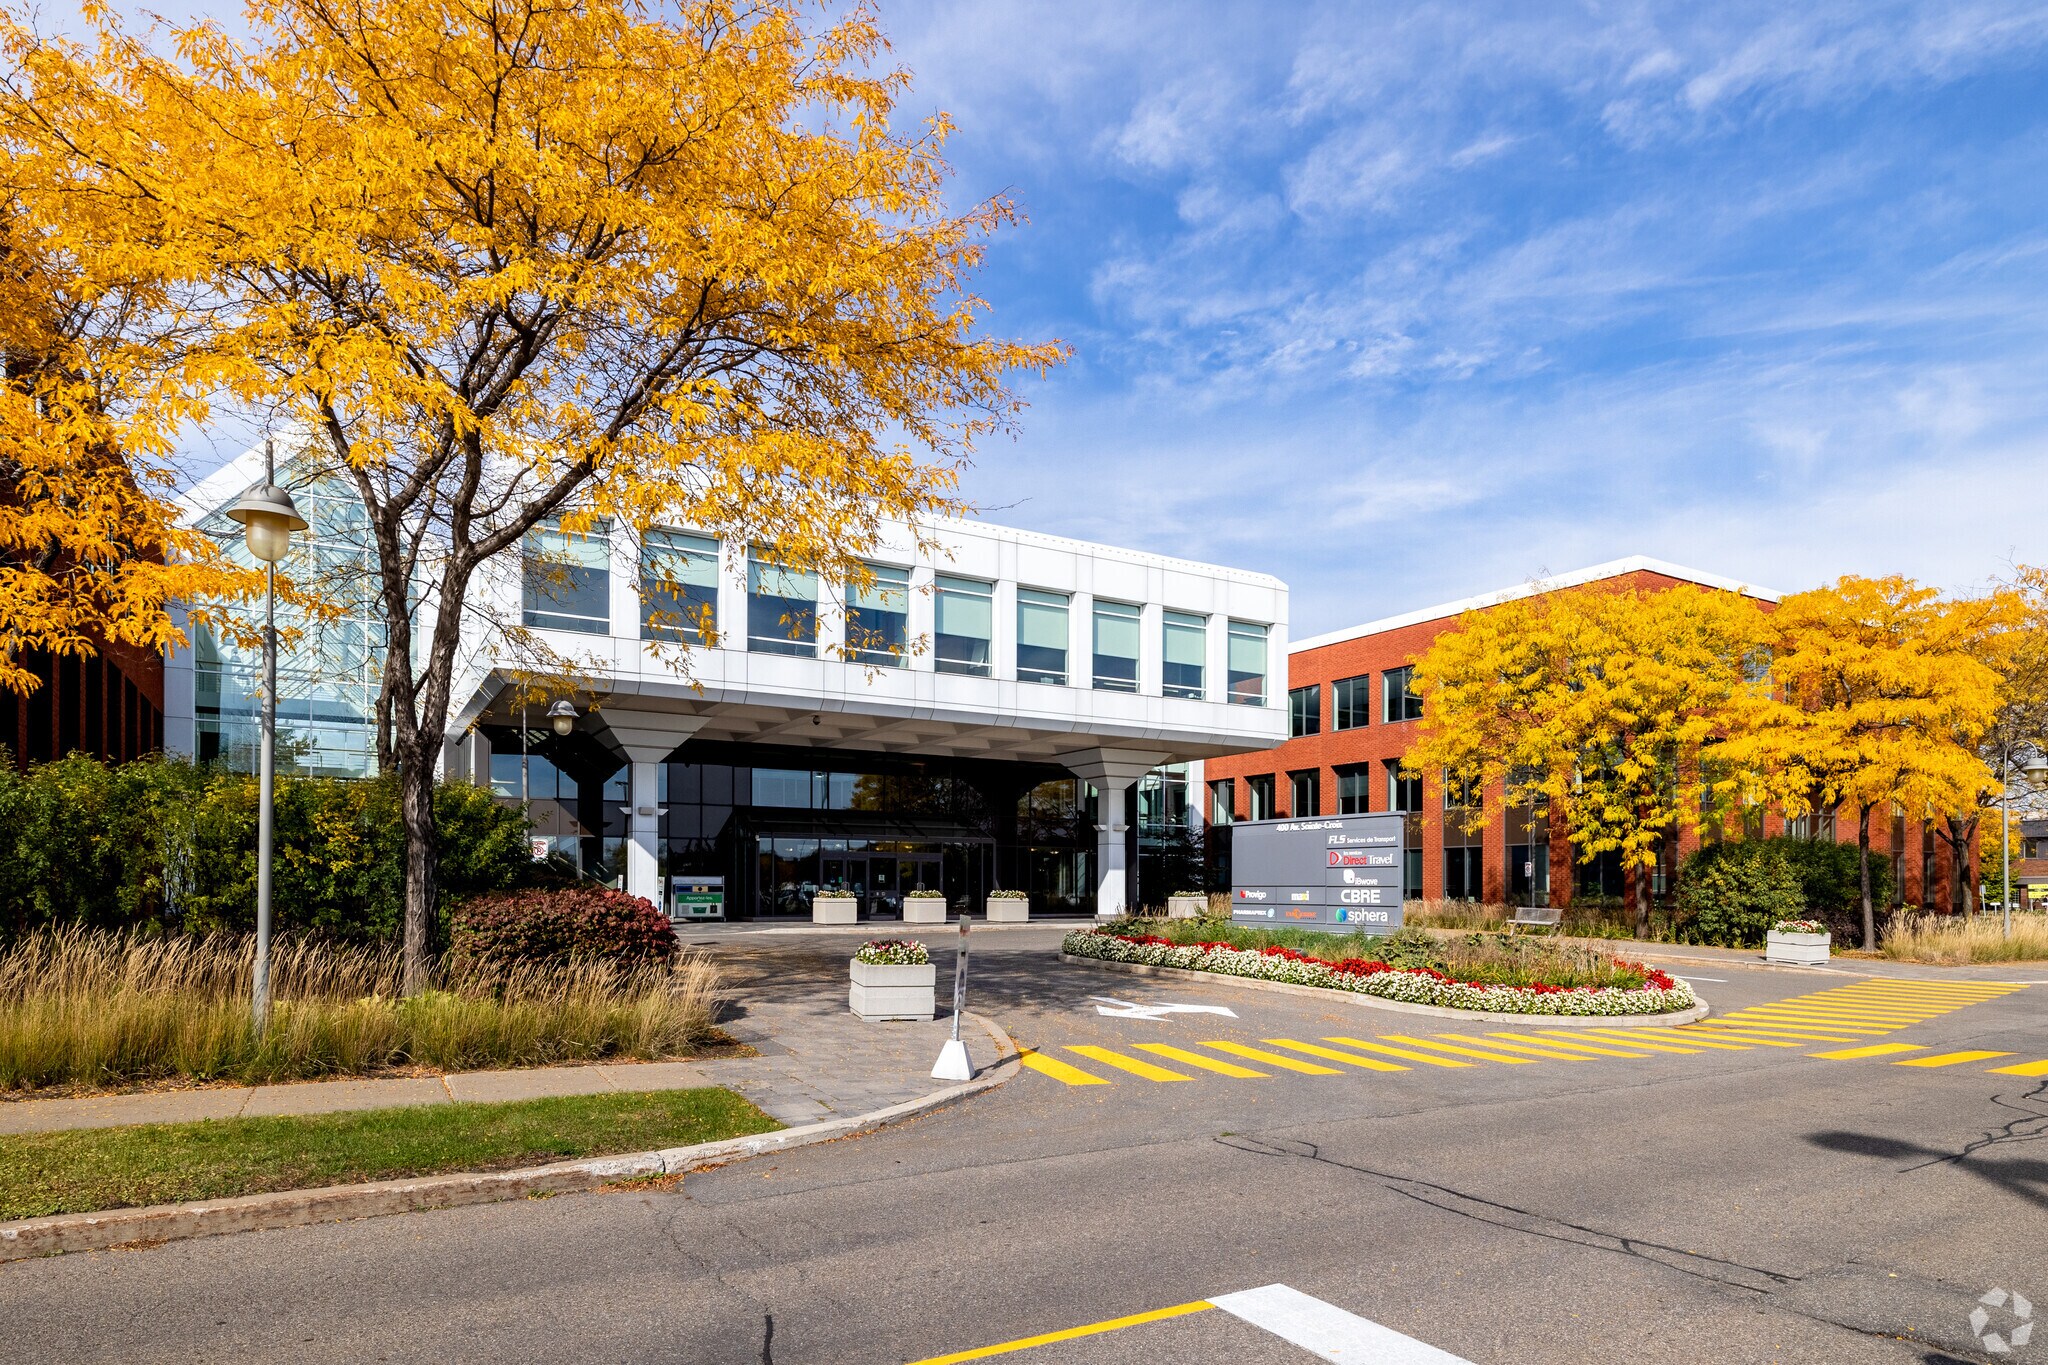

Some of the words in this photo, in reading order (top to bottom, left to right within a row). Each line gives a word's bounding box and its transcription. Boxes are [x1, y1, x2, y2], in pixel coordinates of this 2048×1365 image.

[1276, 823, 1289, 832] 400
[1301, 820, 1343, 831] Sainte-Croix
[1328, 834, 1346, 844] FLS
[1343, 855, 1367, 865] Direct
[1367, 853, 1394, 865] Travel
[1340, 889, 1381, 904] CBRE
[1348, 907, 1388, 924] sphera
